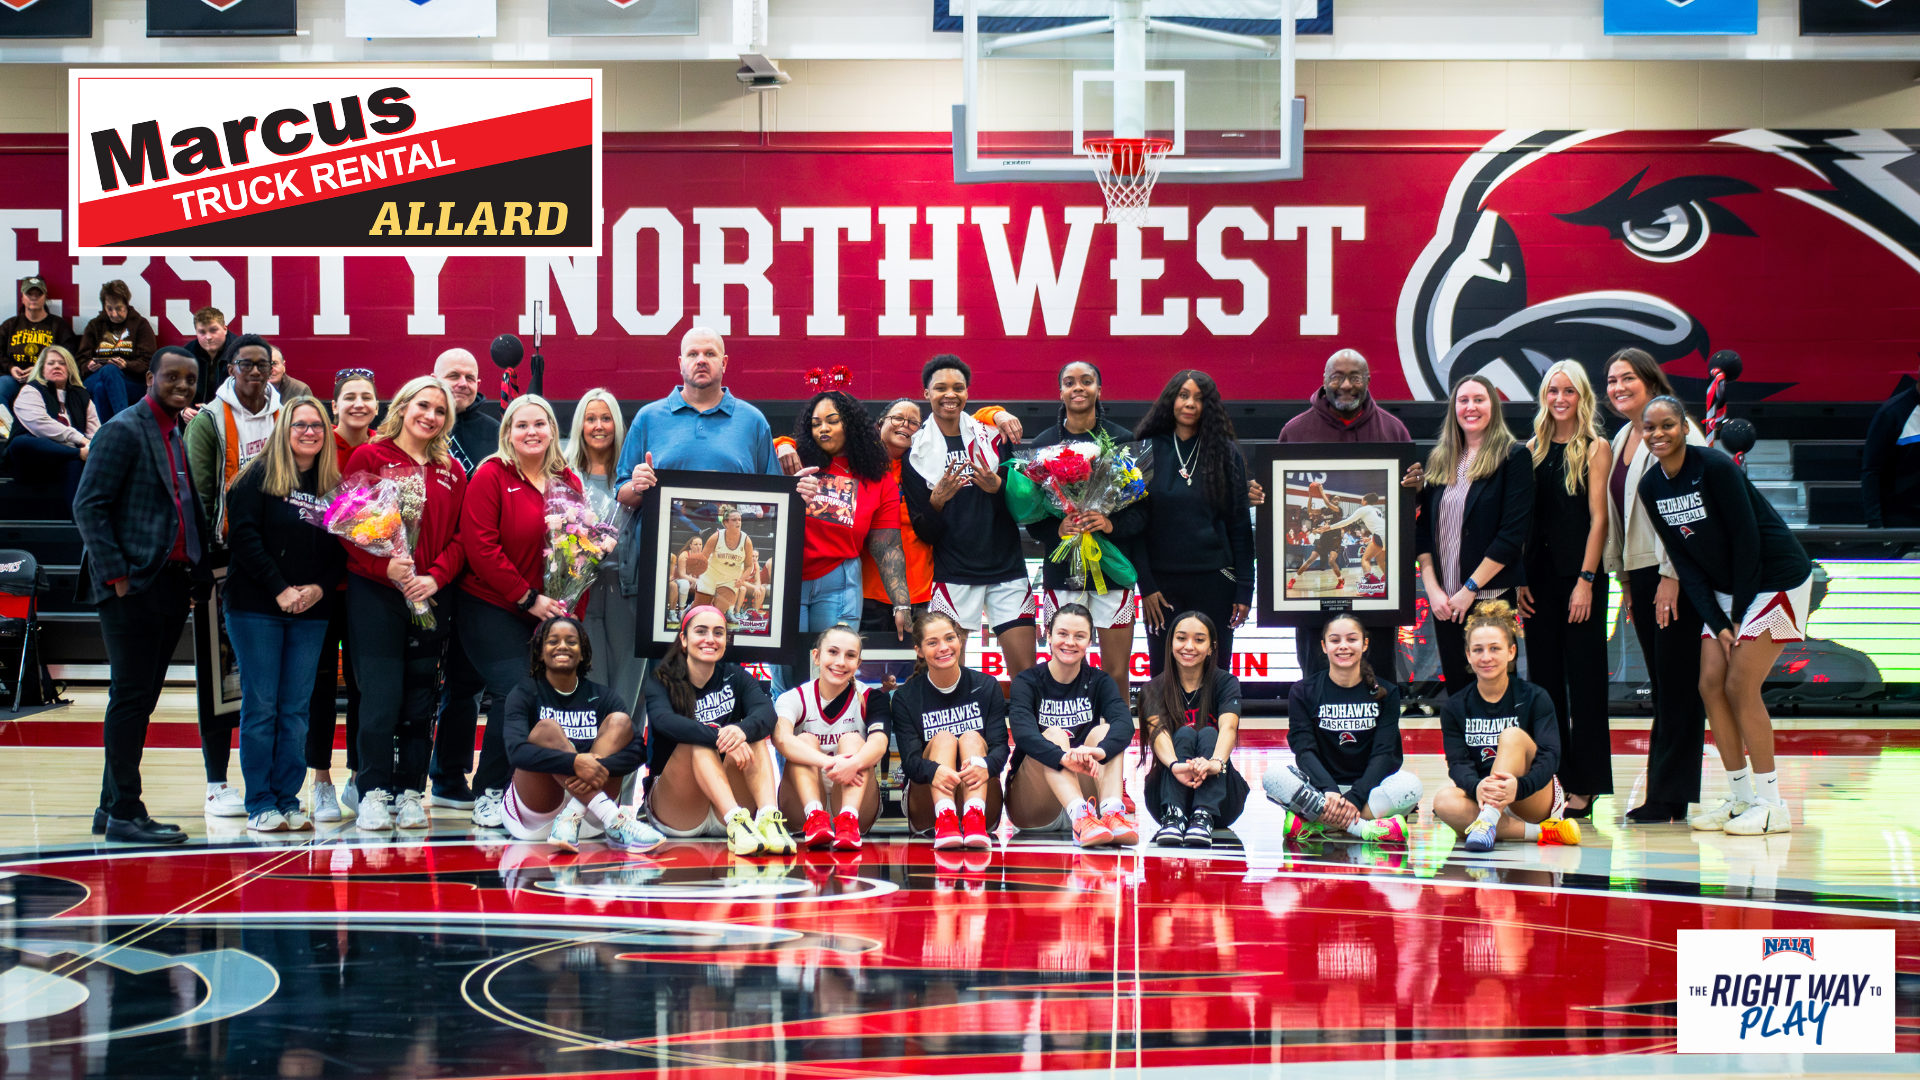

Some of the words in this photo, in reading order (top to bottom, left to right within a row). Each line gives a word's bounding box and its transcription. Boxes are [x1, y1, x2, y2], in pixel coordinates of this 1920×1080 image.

[519, 207, 1365, 335] NORTHWEST
[1656, 491, 1703, 514] REDHAWKS
[1663, 508, 1705, 524] BASKETBALL
[1039, 697, 1092, 716] REDHAWKS
[1318, 702, 1379, 718] REDHAWKS
[922, 702, 981, 728] REDHAWKS
[1039, 711, 1092, 727] BASKETBALL
[1321, 719, 1376, 730] BASKETBALL
[1465, 716, 1520, 733] REDHAWKS
[1467, 735, 1500, 745] BASKET
